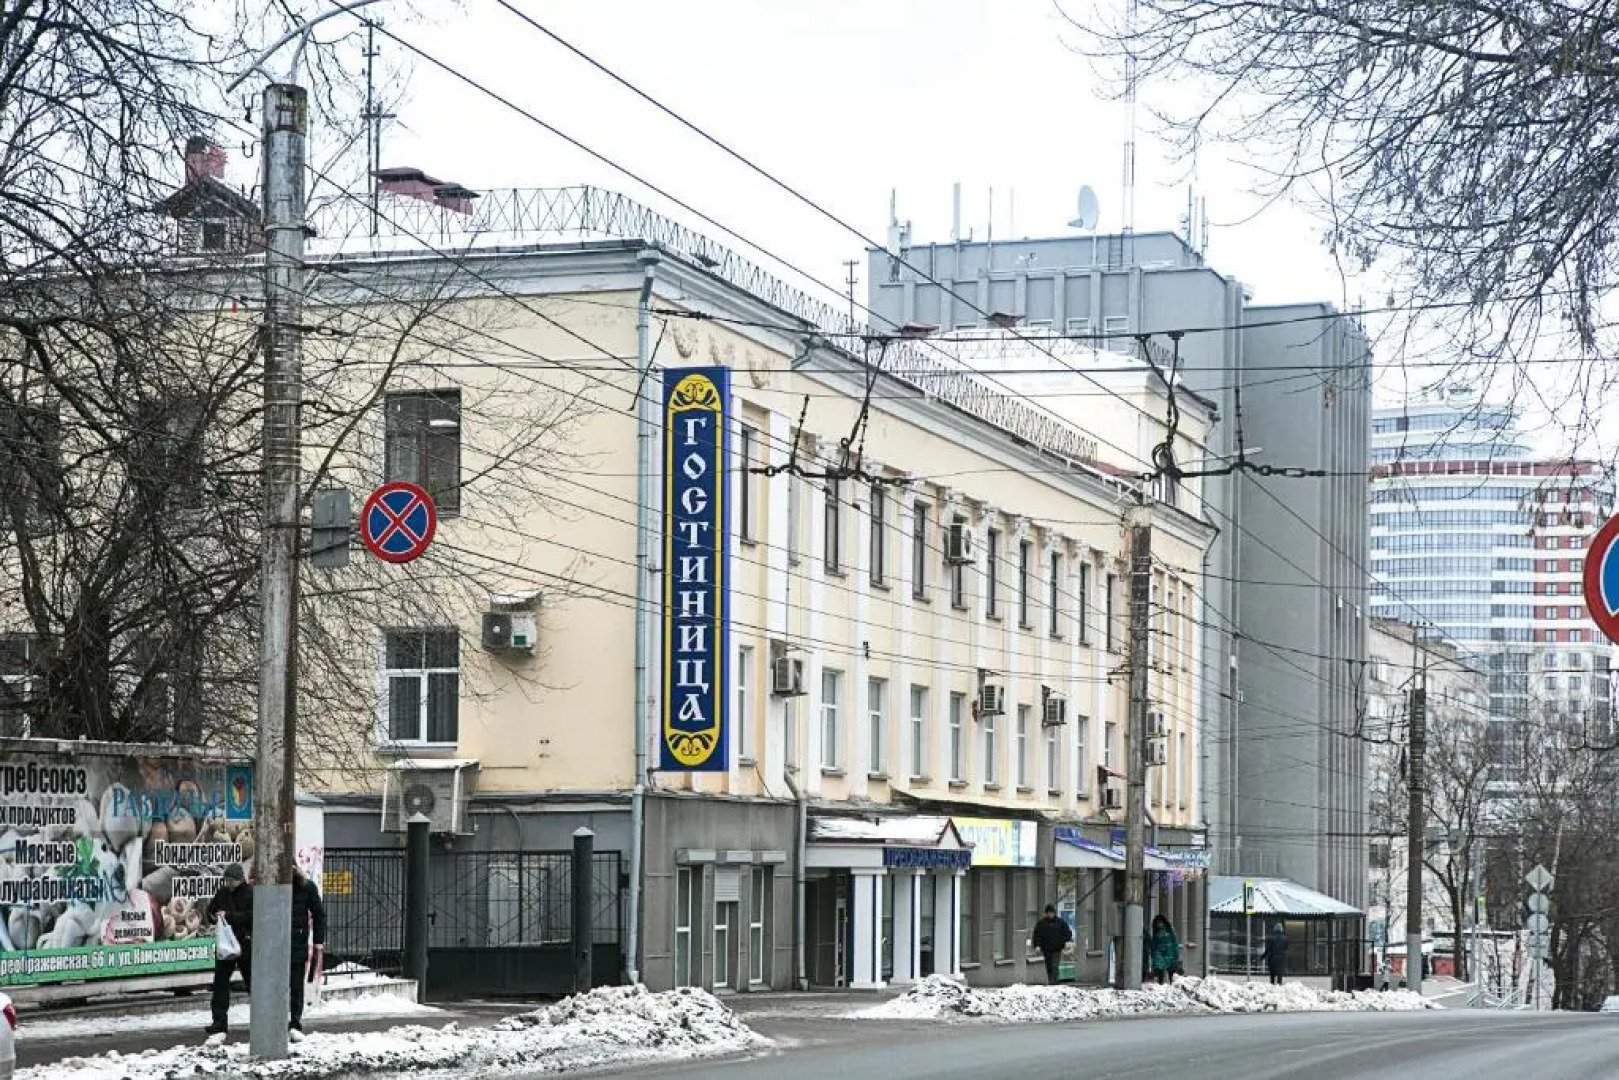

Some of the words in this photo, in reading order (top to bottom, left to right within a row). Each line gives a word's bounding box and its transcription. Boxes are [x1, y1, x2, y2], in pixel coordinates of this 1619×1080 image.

[676, 417, 709, 722] ГОСТИНИЦА
[9, 806, 76, 827] продуктов
[15, 839, 75, 864] Мясные
[156, 841, 241, 867] Кондитерские
[2, 876, 104, 903] луфабрикаты
[108, 952, 115, 967] и
